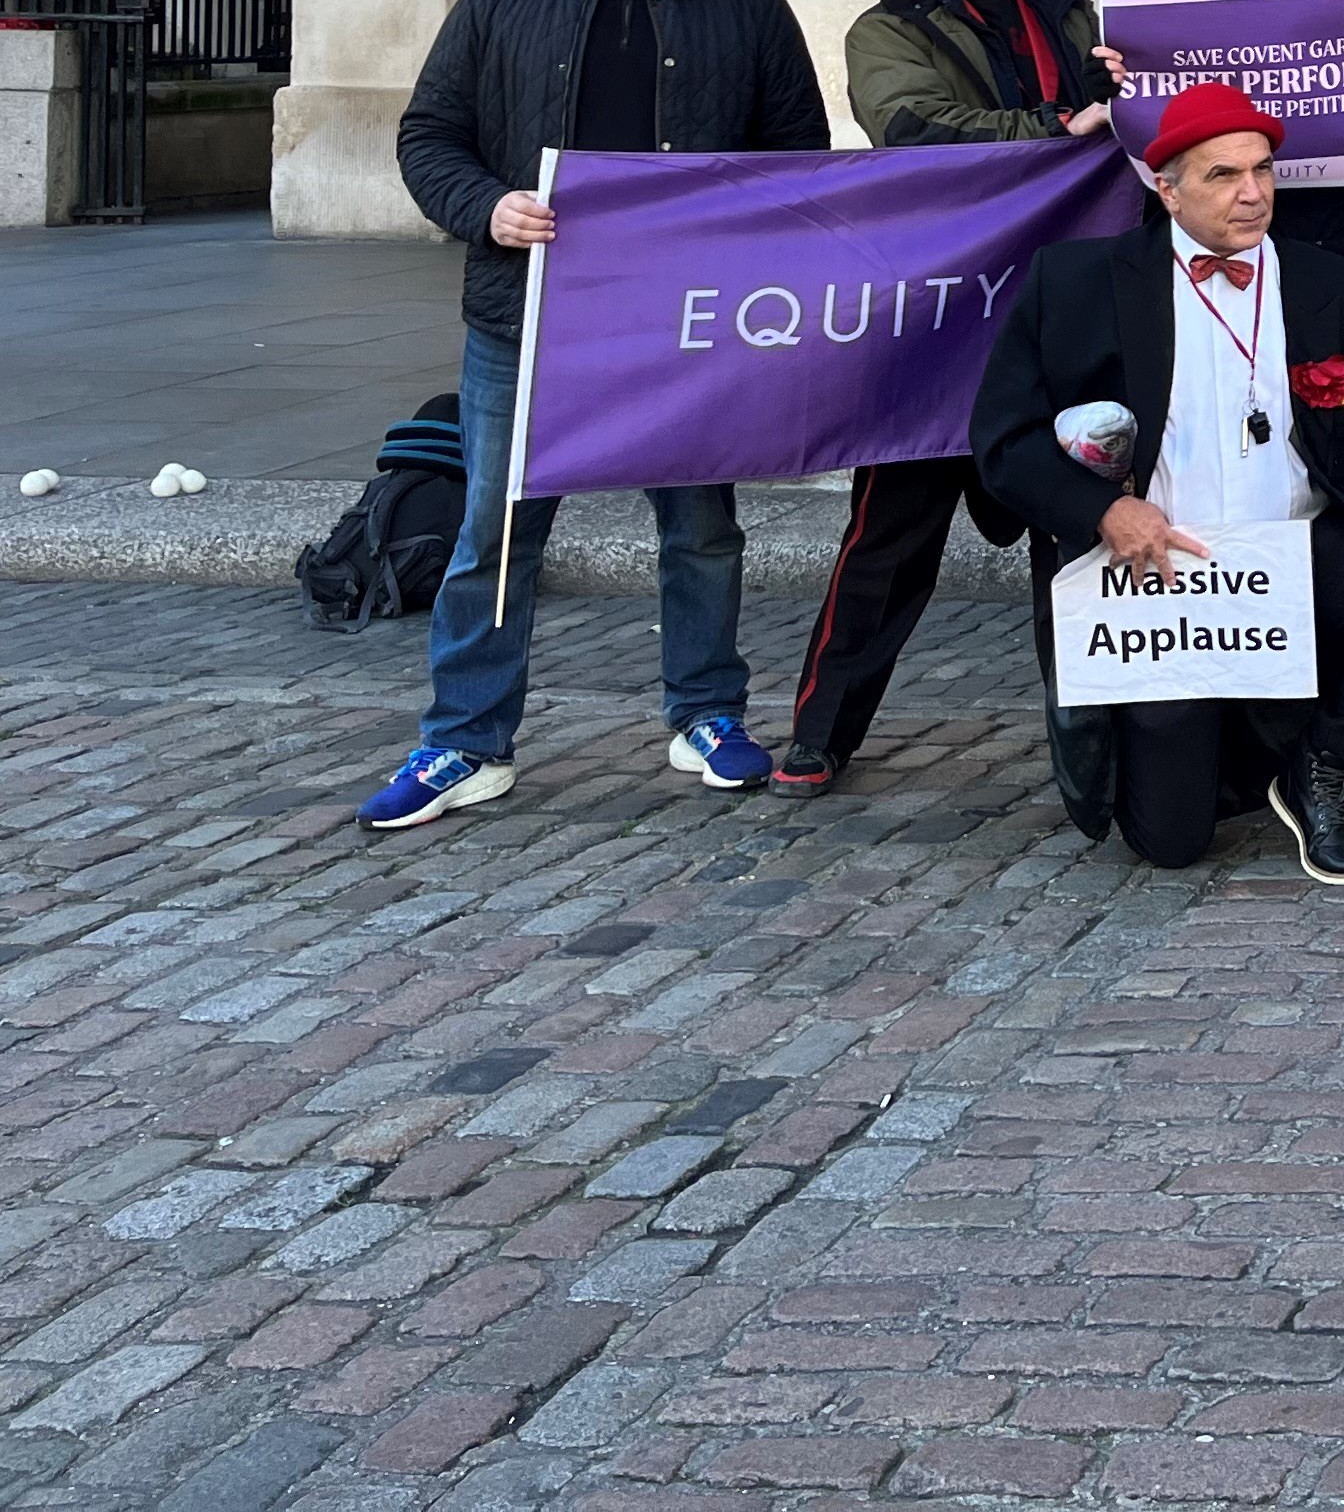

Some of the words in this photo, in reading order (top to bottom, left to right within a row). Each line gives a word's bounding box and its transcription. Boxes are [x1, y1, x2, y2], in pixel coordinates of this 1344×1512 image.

[1172, 48, 1224, 67] SAVE
[1226, 41, 1307, 65] COVENT
[1279, 163, 1328, 179] UITY
[679, 264, 1016, 350] EQUITY
[1101, 561, 1271, 598] Massive
[1087, 616, 1289, 664] Applause
